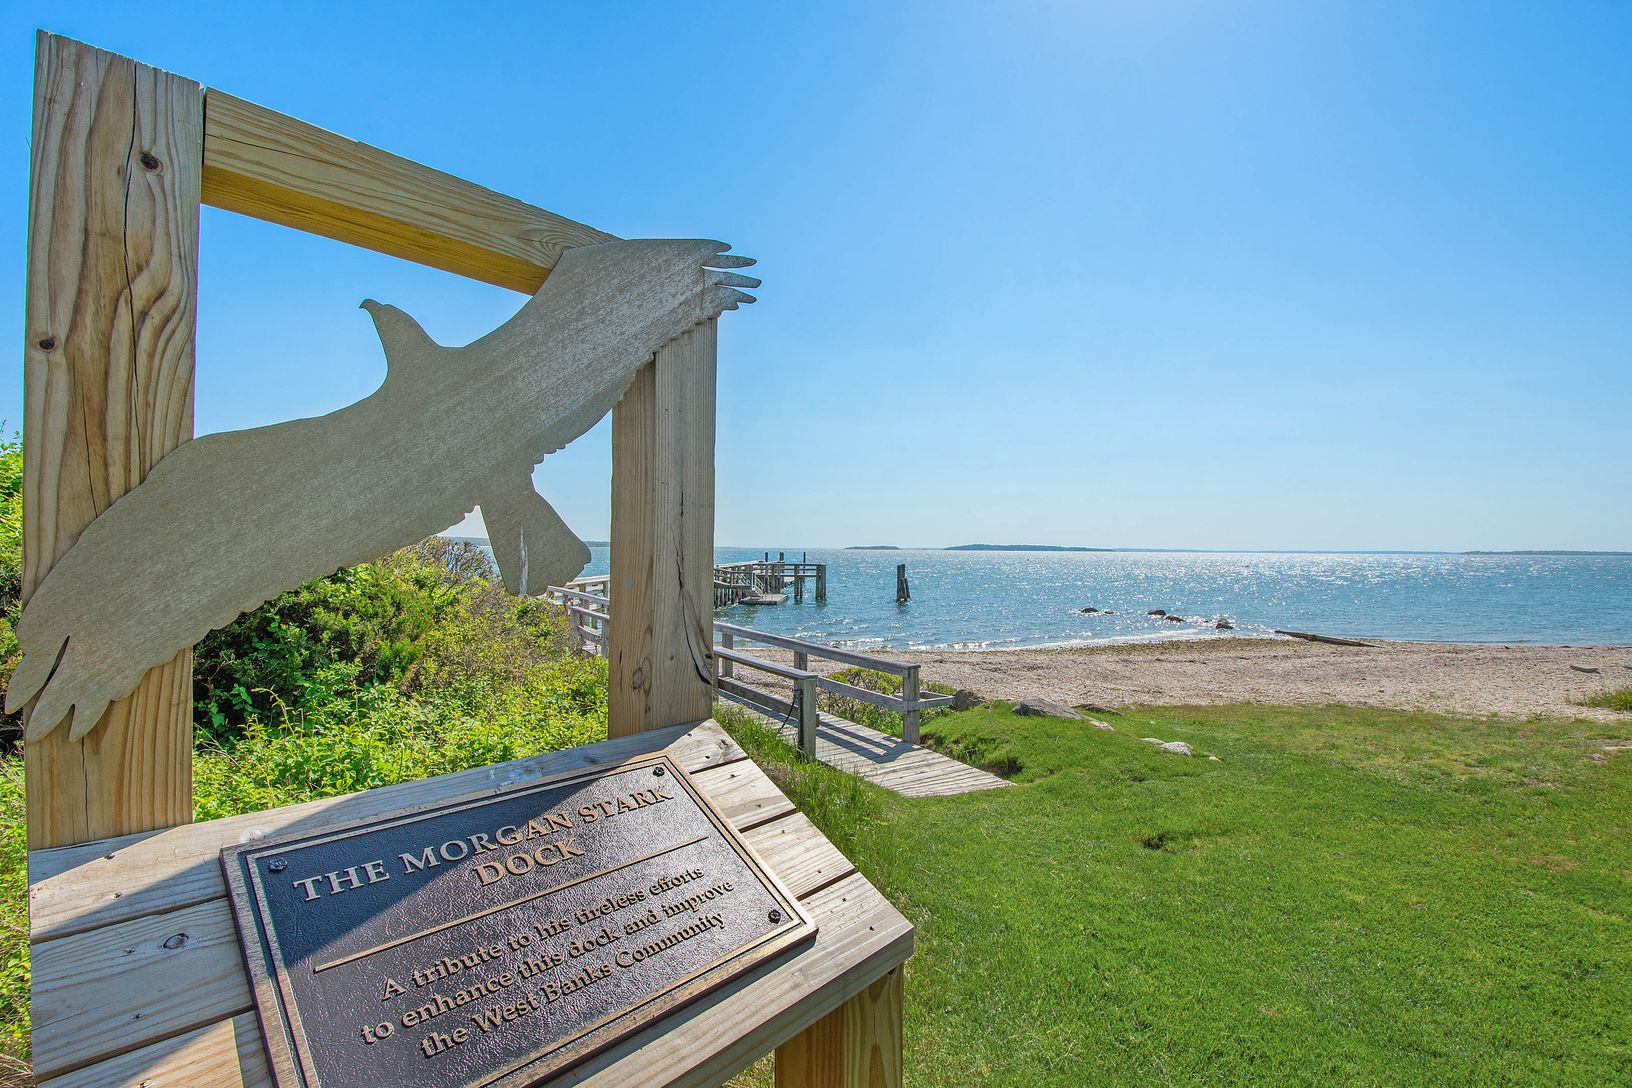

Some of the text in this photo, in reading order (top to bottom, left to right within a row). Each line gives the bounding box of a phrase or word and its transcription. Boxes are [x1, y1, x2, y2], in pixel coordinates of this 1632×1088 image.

[292, 785, 674, 901] THE MORGAN STARK
[473, 838, 584, 886] DOCK
[361, 880, 735, 1044] to enhance this dock and improve
[382, 866, 704, 1001] A tribute to his tireless efforts
[421, 911, 726, 1058] the West Banks Community
